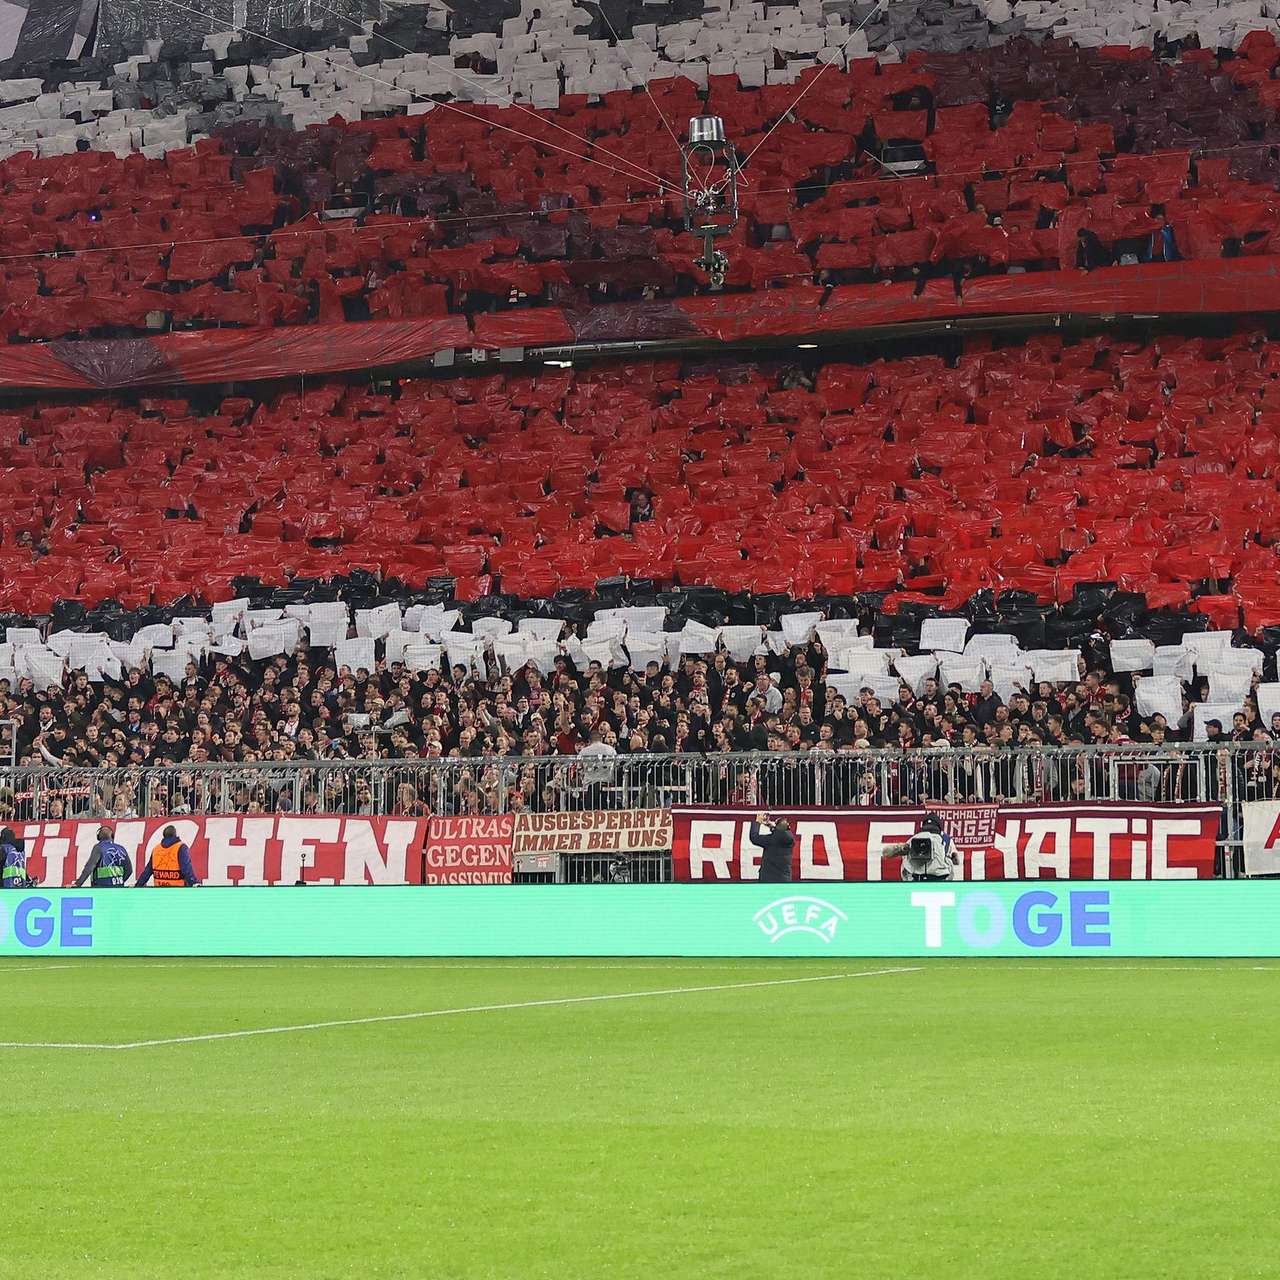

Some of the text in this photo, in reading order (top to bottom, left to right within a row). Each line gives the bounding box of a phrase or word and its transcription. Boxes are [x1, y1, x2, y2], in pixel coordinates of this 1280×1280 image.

[516, 808, 672, 833] AUSGESPERRTE
[513, 829, 669, 853] IMMER BEI UNS
[426, 844, 512, 868] GEGEN
[757, 903, 839, 938] UEFA
[910, 890, 1112, 949] TOGE
